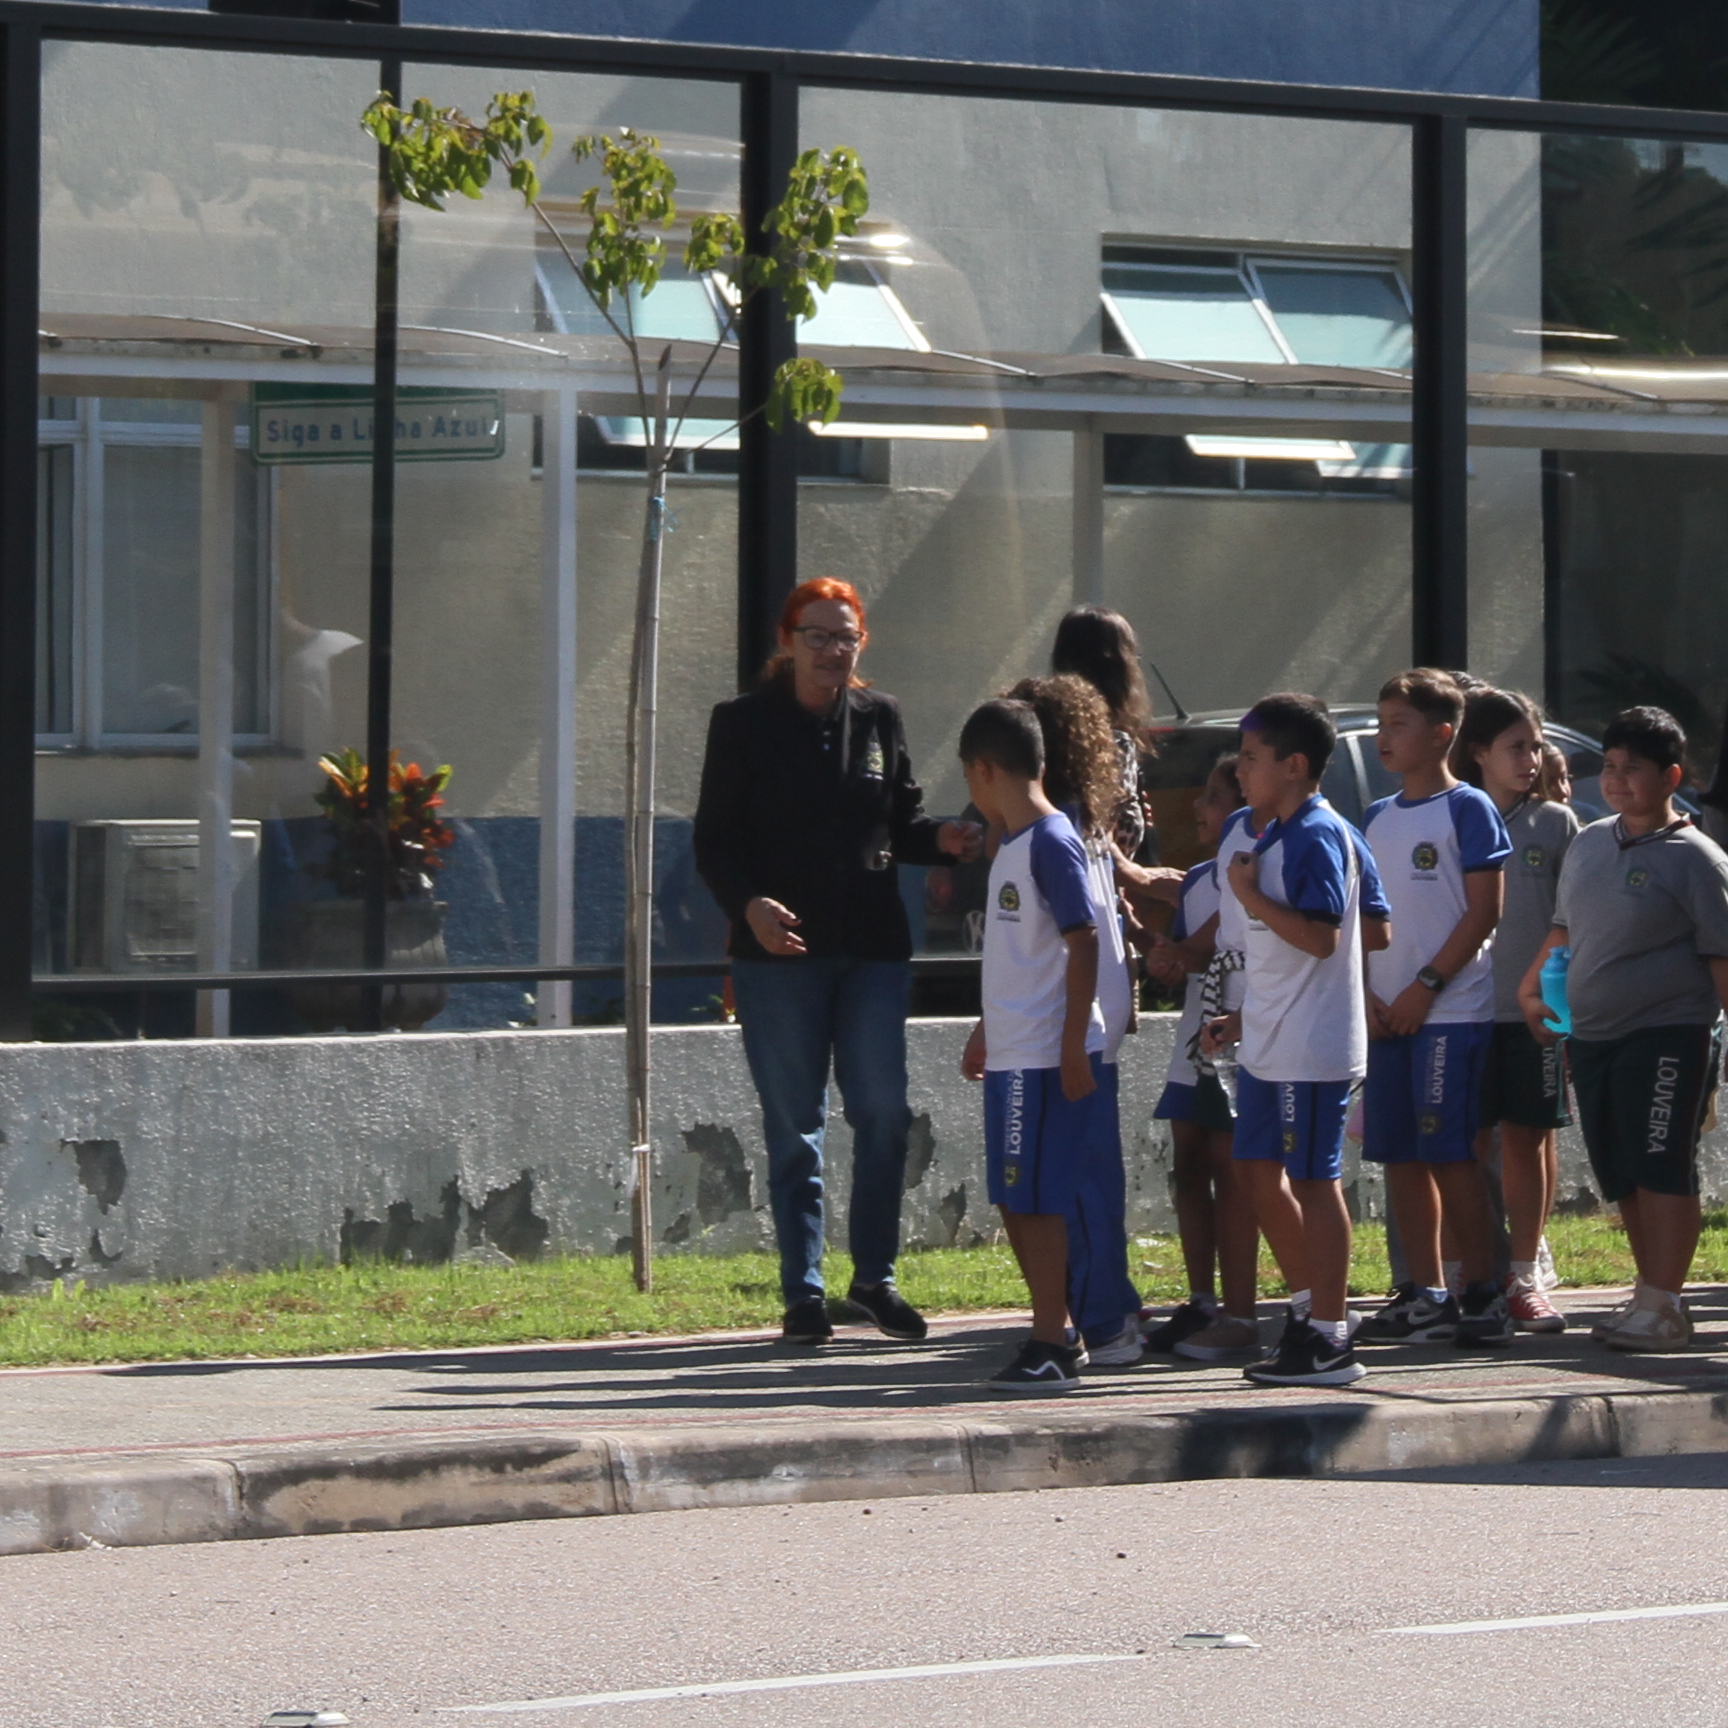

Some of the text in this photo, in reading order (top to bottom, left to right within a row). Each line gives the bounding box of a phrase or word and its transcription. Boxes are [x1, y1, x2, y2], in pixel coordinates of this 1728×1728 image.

[266, 419, 320, 447] Siga
[330, 424, 343, 440] a
[353, 418, 422, 441] Liha
[1432, 1035, 1448, 1104] LOUVEIRA
[1647, 1056, 1680, 1153] LOUVEIRA
